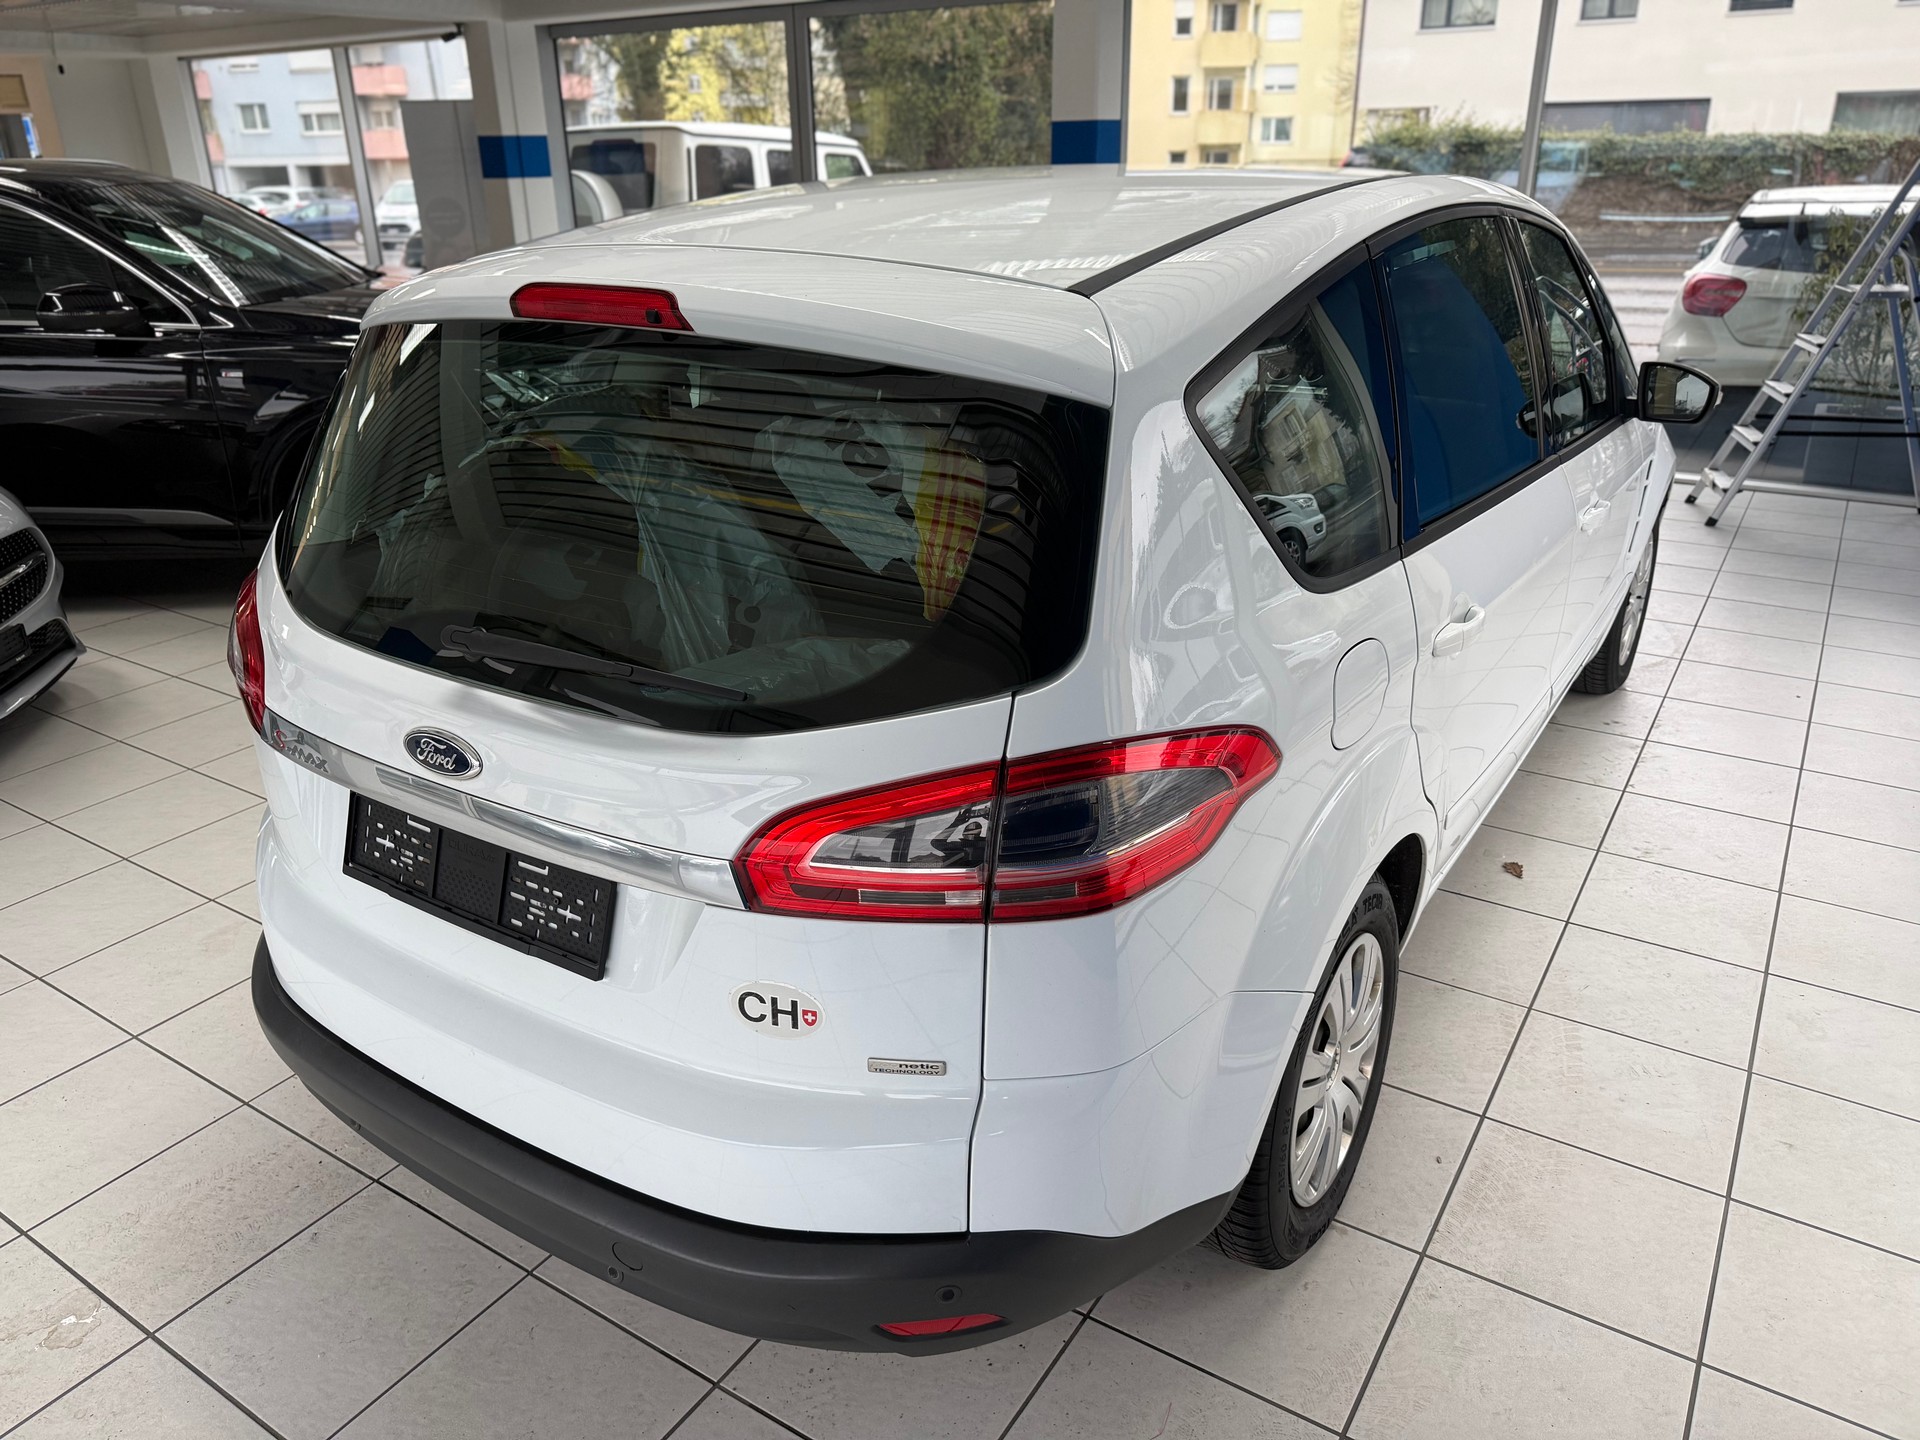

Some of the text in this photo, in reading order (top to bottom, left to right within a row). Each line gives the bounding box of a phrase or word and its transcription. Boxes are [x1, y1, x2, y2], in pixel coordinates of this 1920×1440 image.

[417, 737, 457, 771] Ford
[738, 990, 799, 1030] CH
[873, 1067, 940, 1075] TECHNOLOGY
